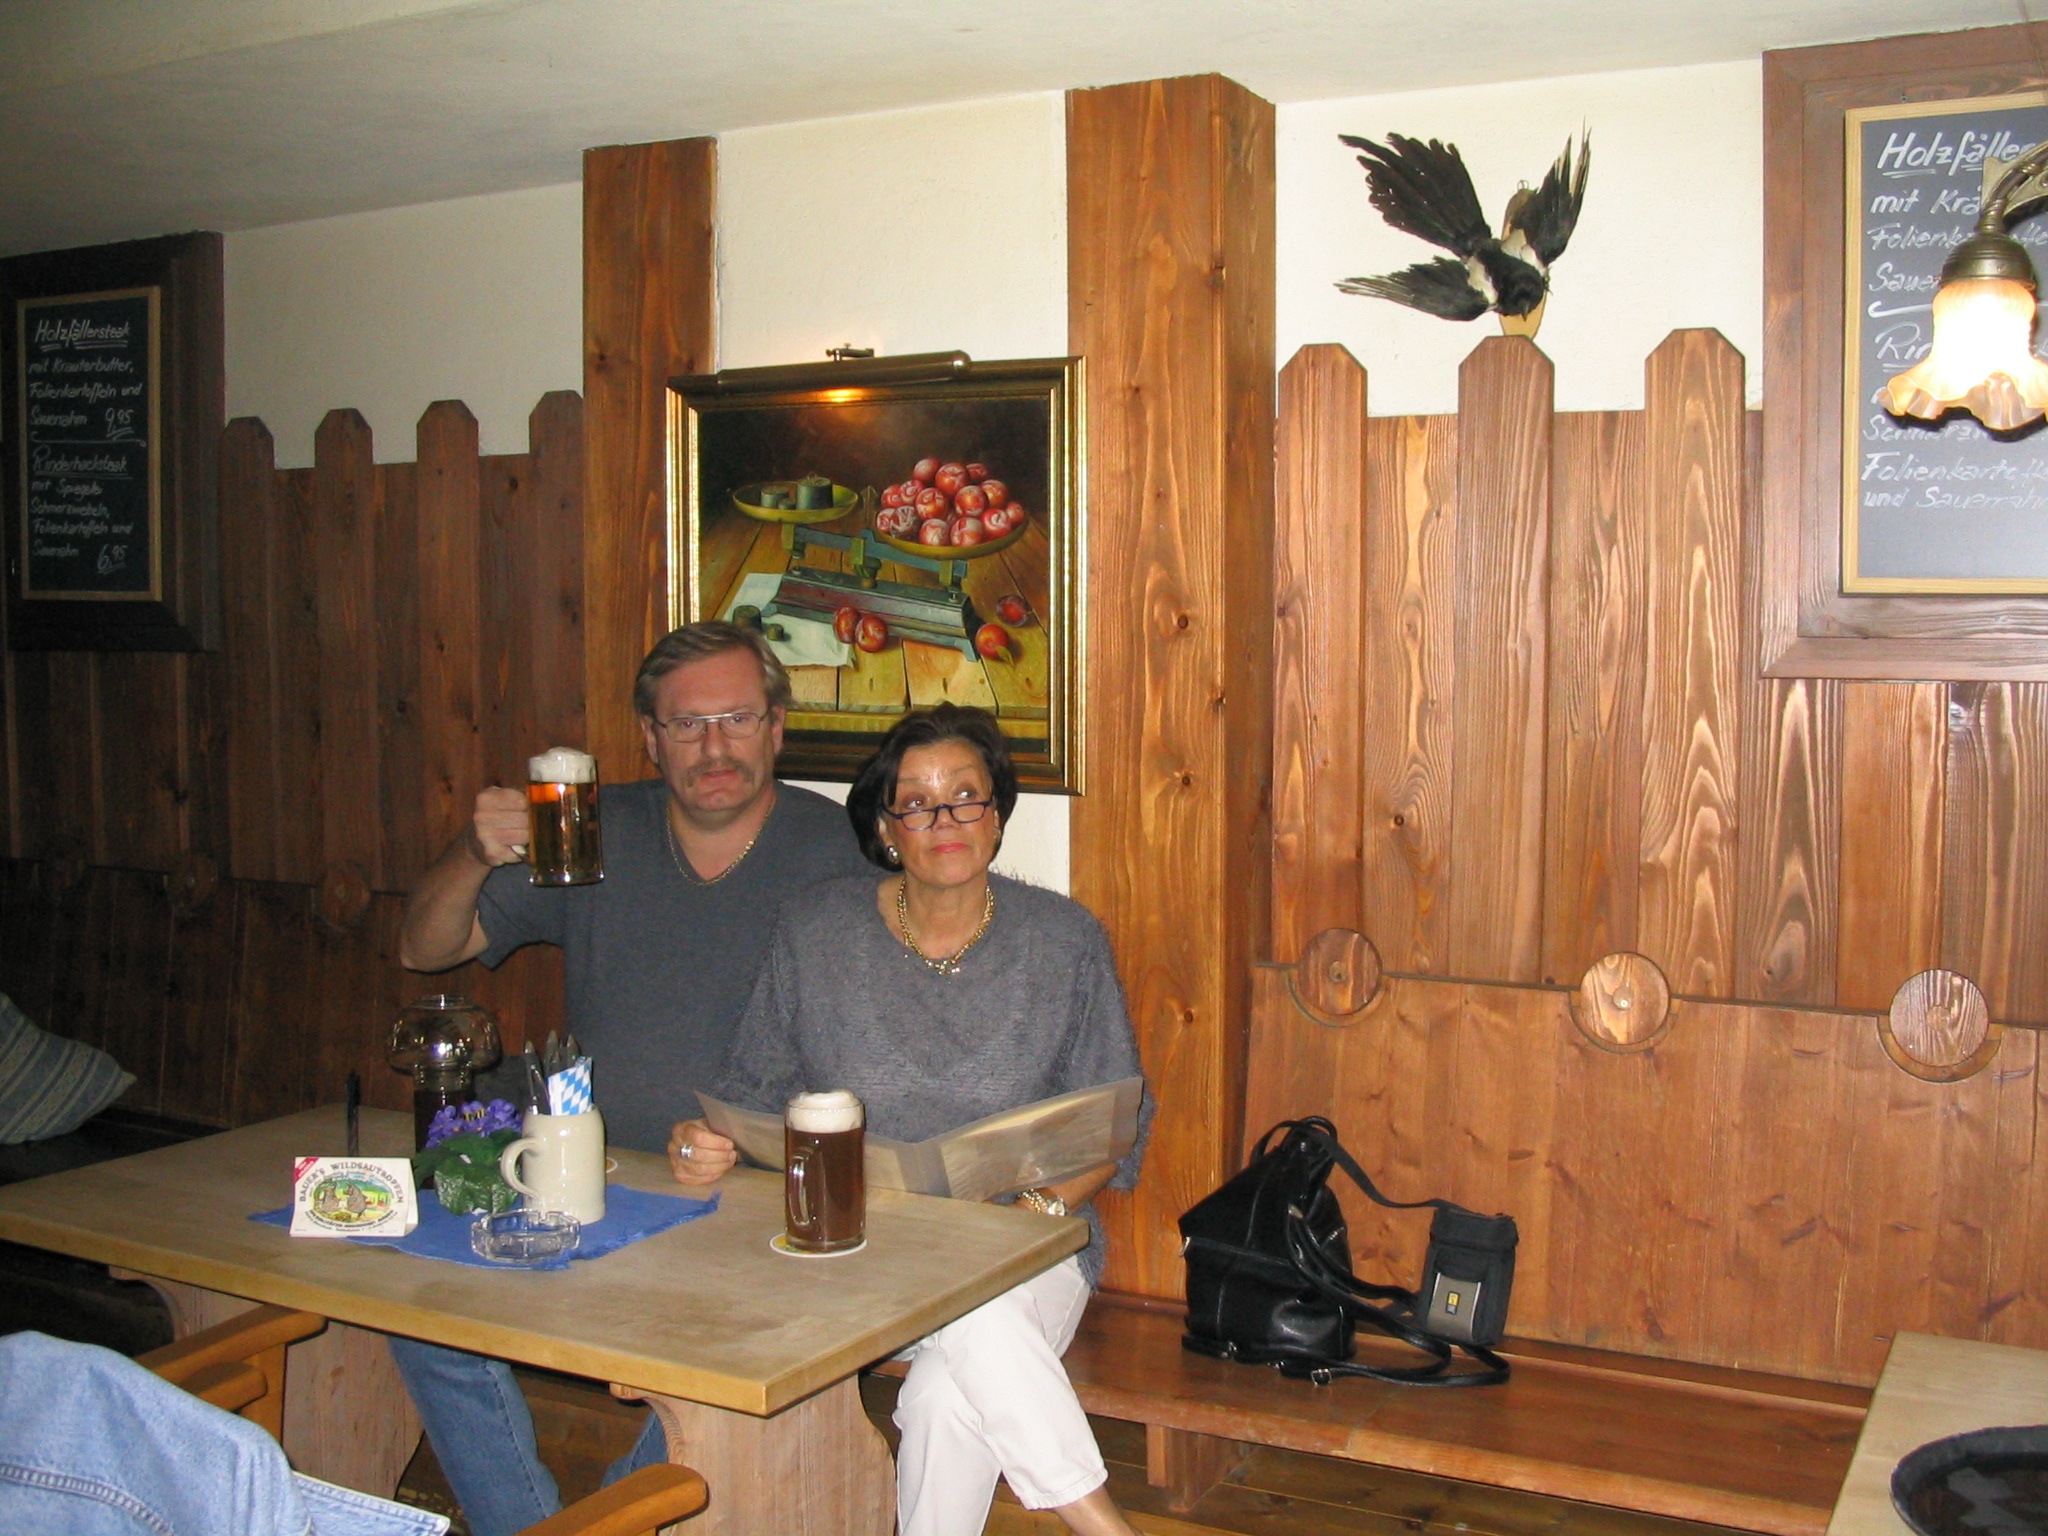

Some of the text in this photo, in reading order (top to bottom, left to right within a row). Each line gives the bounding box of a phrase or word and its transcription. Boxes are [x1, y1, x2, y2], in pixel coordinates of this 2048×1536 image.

[1877, 131, 2036, 176] Holzfäller
[1870, 189, 1920, 214] mit
[35, 319, 130, 348] Holzfällersteak
[29, 359, 49, 374] mit
[30, 382, 143, 404] Folienkartoffeln und
[31, 480, 51, 491] mit
[1863, 487, 1910, 508] und
[112, 522, 134, 535] und
[299, 1168, 325, 1202] BAUER'S
[331, 1161, 404, 1203] WILDSAUTROPFEN
